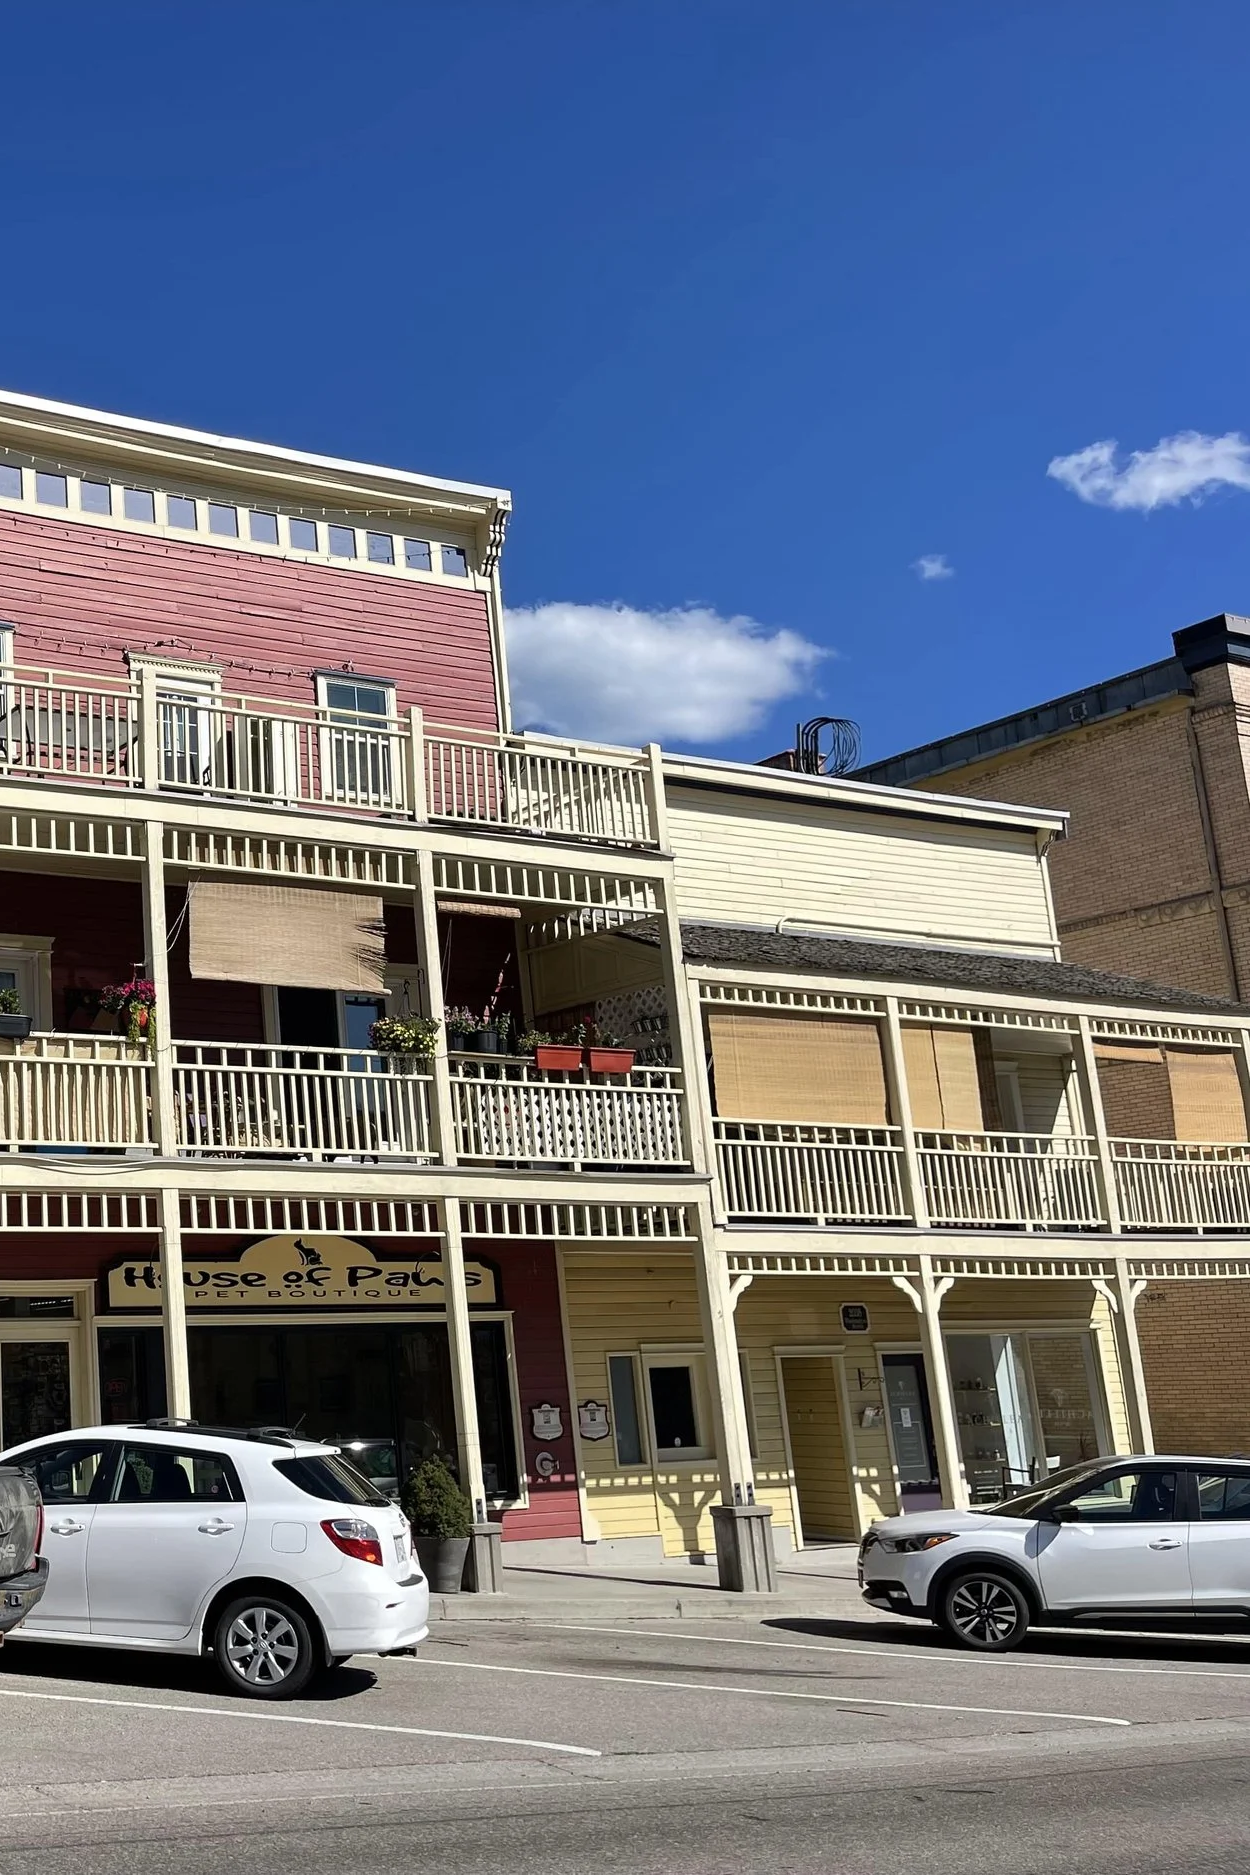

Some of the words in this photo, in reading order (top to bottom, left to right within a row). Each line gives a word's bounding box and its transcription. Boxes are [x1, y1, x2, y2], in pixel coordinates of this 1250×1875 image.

[124, 1266, 266, 1289] Huse
[283, 1266, 332, 1287] of
[195, 1290, 248, 1298] PET
[267, 1289, 421, 1298] BOUTIQUE
